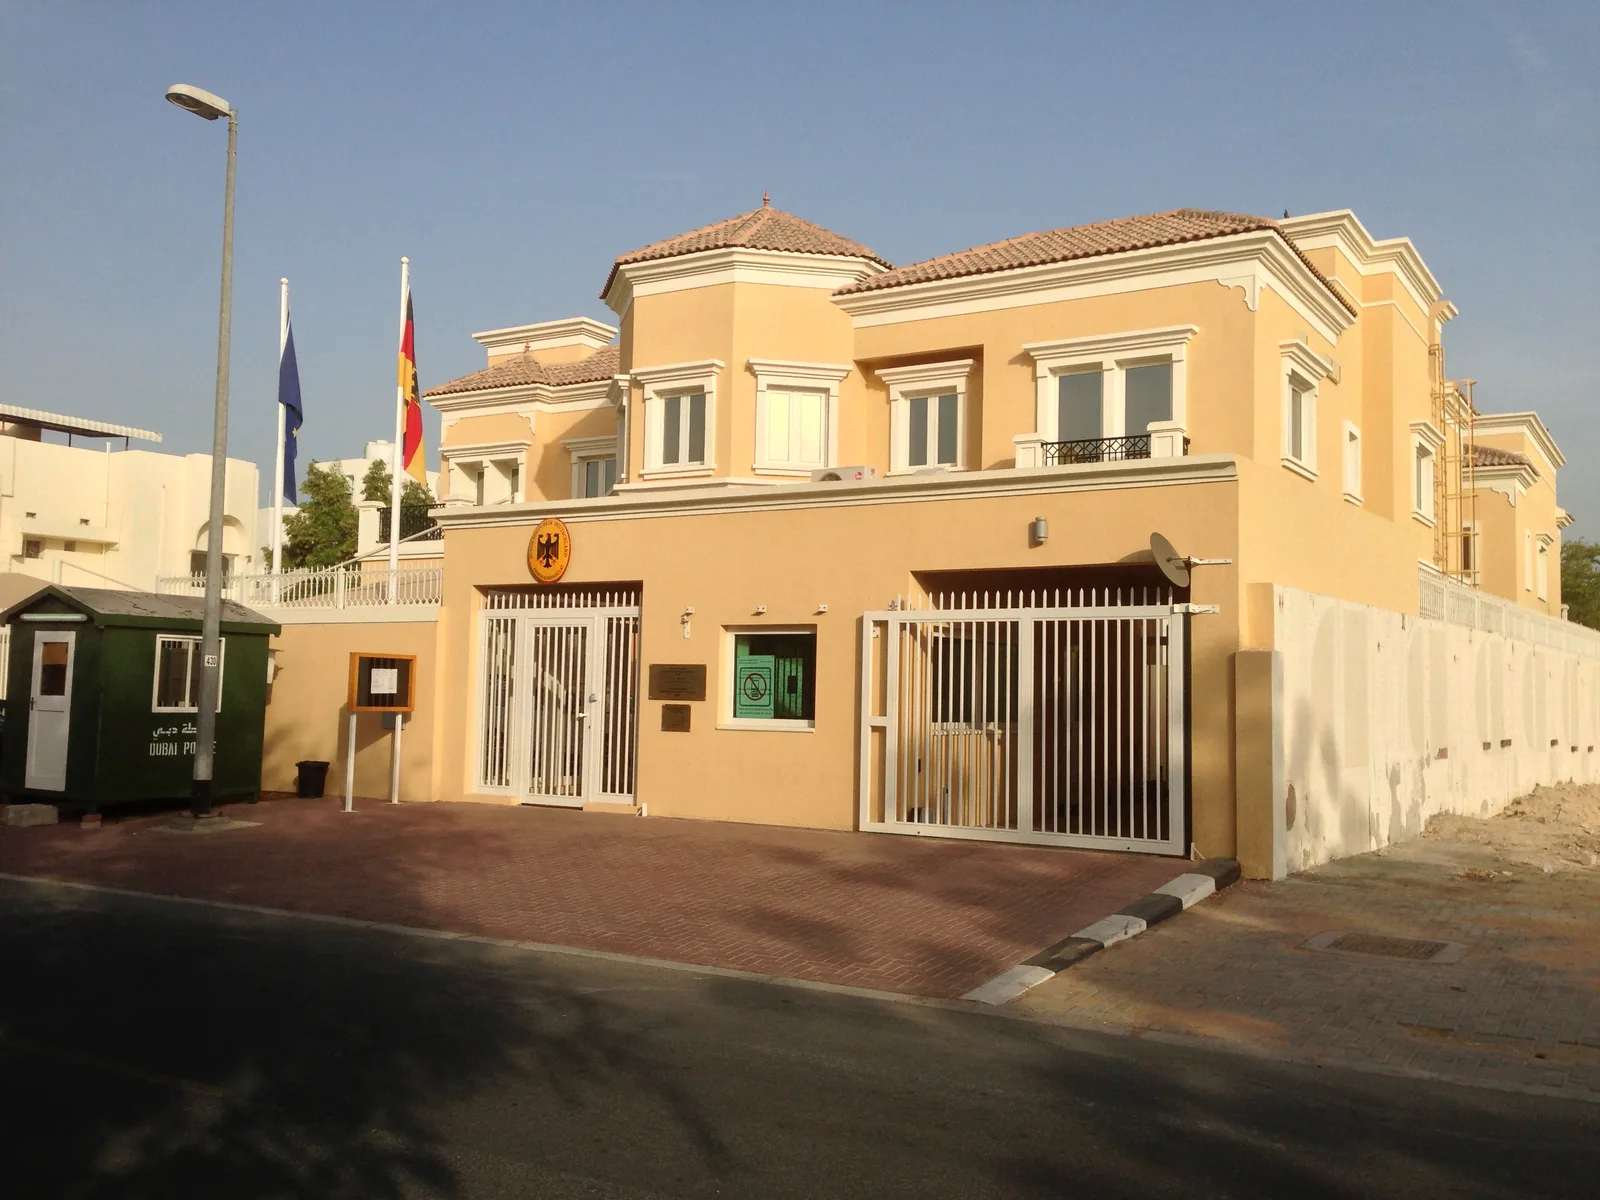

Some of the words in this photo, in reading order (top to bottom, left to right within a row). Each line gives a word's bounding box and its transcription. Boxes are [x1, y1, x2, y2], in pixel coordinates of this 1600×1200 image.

[152, 727, 178, 741] دبي
[149, 742, 177, 756] DUBAI
[183, 741, 217, 756] POE
